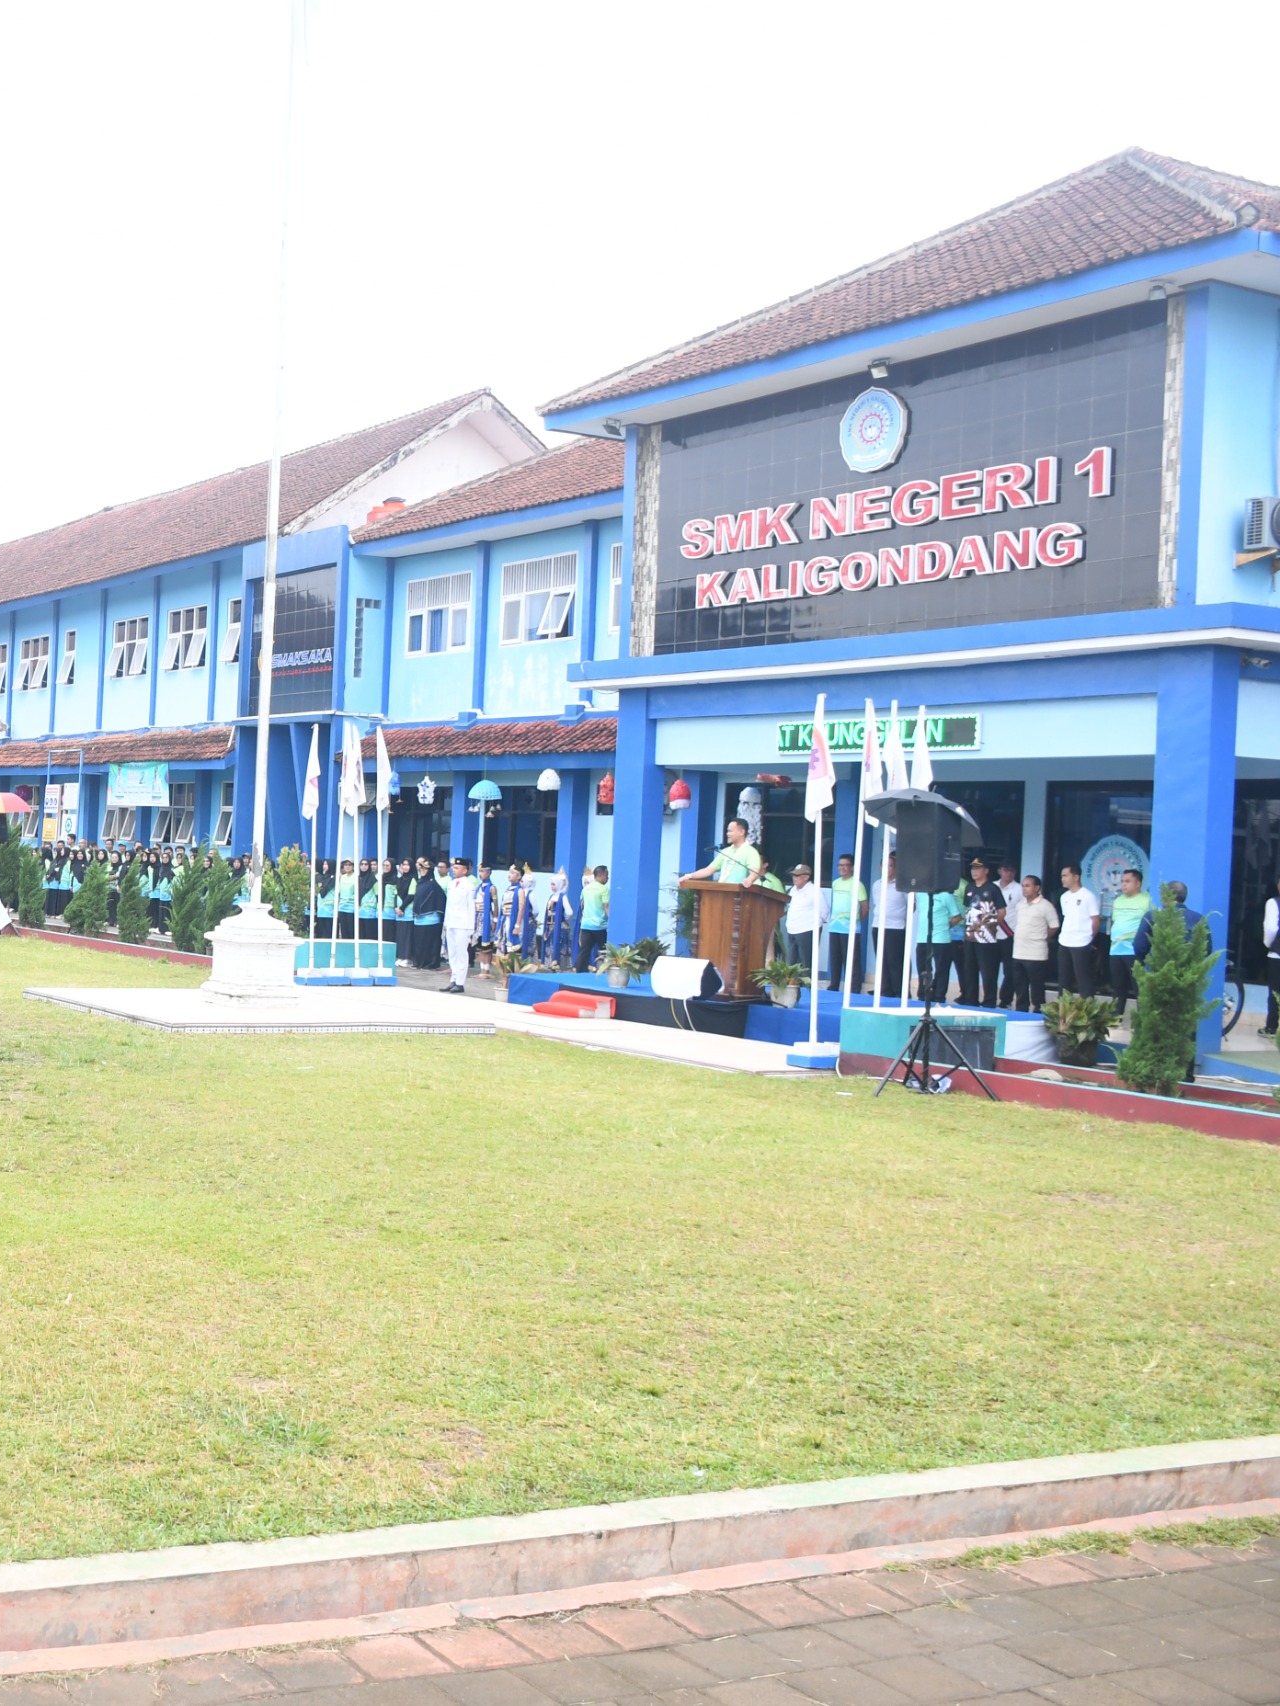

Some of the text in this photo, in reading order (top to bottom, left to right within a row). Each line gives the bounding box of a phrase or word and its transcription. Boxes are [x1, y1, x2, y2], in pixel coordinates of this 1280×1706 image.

[680, 446, 1112, 559] SMK NEGERI 1
[695, 522, 1084, 608] KALIGONDANG
[272, 647, 333, 669] SMAKSAKA
